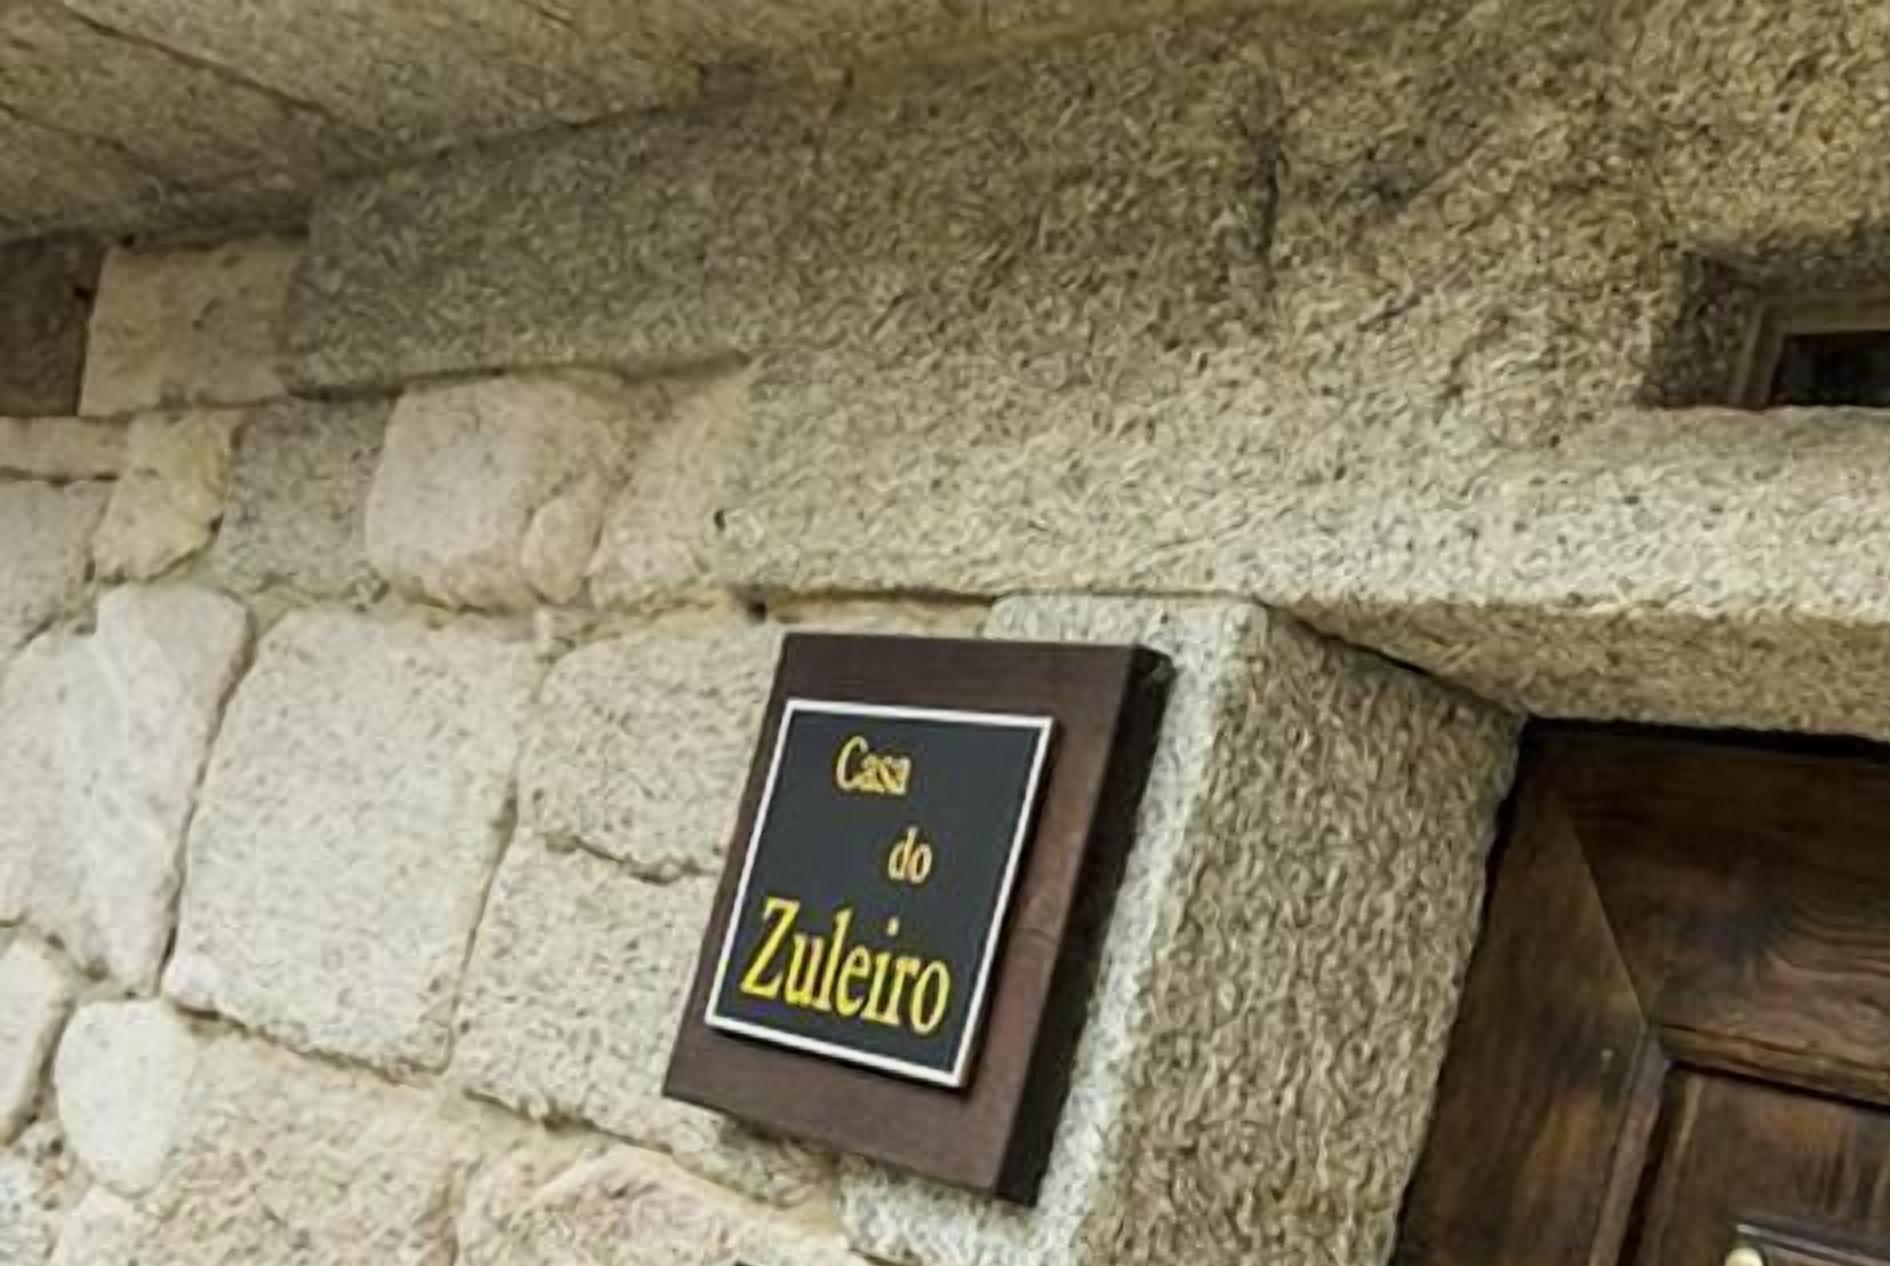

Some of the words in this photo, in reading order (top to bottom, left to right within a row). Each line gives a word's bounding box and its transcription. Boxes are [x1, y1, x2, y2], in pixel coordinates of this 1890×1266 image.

[836, 736, 911, 794] Casa
[887, 827, 932, 883] do
[740, 897, 951, 1034] Zuleiro
